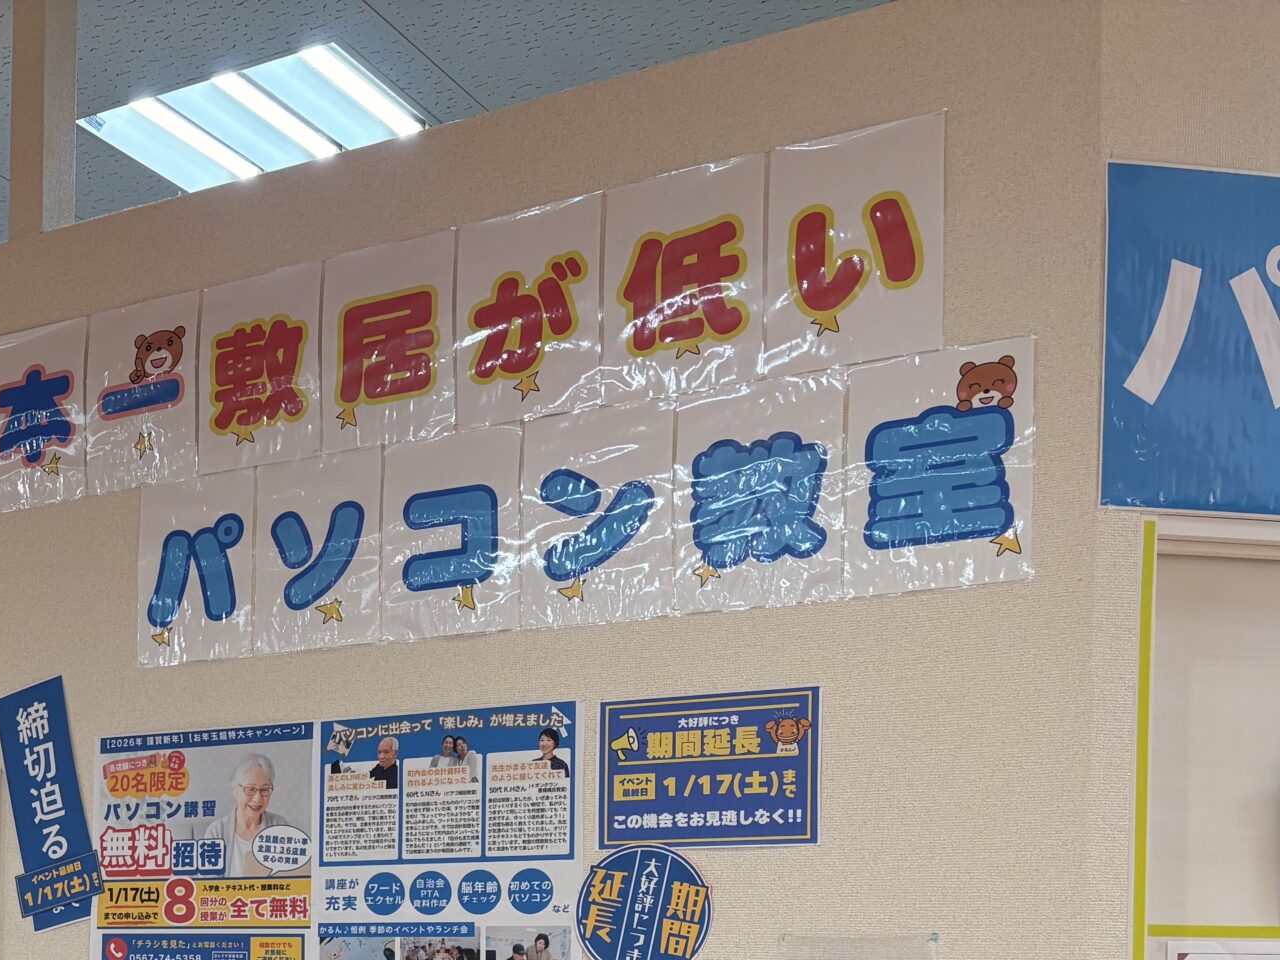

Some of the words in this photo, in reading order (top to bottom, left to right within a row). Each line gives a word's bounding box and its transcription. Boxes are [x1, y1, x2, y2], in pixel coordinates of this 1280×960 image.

[147, 405, 1014, 629] パソコン教室
[677, 714, 740, 729] 大好評につき
[335, 714, 564, 742] パソコンに出会って「楽しみ」が増えました
[106, 738, 143, 749] 【2026年
[646, 725, 762, 759] 期間延長
[109, 759, 148, 772] 各店舗につき
[491, 762, 549, 773] 先生がまるで友達
[407, 767, 468, 778] 町内会の会計資料を
[491, 771, 561, 782] のように接してくれて
[16, 700, 69, 859] 締切迫る
[109, 771, 187, 793] 20名限定
[407, 776, 467, 788] 作れるようになった
[618, 775, 654, 787] イベント
[662, 769, 780, 799] 1/17(土)
[782, 769, 798, 799] まで
[406, 790, 420, 798] 60代
[489, 786, 503, 794] 50代
[621, 787, 649, 798] 最終日
[327, 795, 339, 803] 70代
[104, 800, 217, 821] パソコン講習
[613, 808, 803, 830] この機会をお見逃しなく!!
[258, 834, 309, 846] 今話題の習い事
[100, 824, 173, 869] 無料
[257, 845, 307, 857] 全国136店舗
[173, 840, 225, 869] 招待
[262, 855, 299, 865] 安心の実績
[30, 861, 83, 886] イベント最終日
[324, 878, 360, 891] 講座が
[368, 882, 401, 894] ワード
[415, 878, 446, 889] 自治会
[461, 881, 499, 894] 脳年齢
[509, 879, 552, 891] 初めての
[23, 874, 92, 908] 1/17(土)
[107, 886, 161, 905] 1/17(土)
[420, 889, 440, 899] PTA
[163, 877, 197, 925] 8
[200, 897, 228, 908] 回分の
[325, 895, 358, 911] 充実
[365, 894, 404, 905] エクセル
[412, 898, 448, 909] 資料作成
[461, 894, 498, 904] チェック
[509, 892, 552, 904] パソコン
[230, 896, 309, 919] 全て無料
[552, 904, 570, 914] など
[581, 867, 629, 943] 延長
[104, 911, 159, 921] までの申し込みで
[200, 910, 228, 922] 授業が
[659, 880, 710, 960] 期間
[369, 924, 469, 935] 季節のイベントやランチ会
